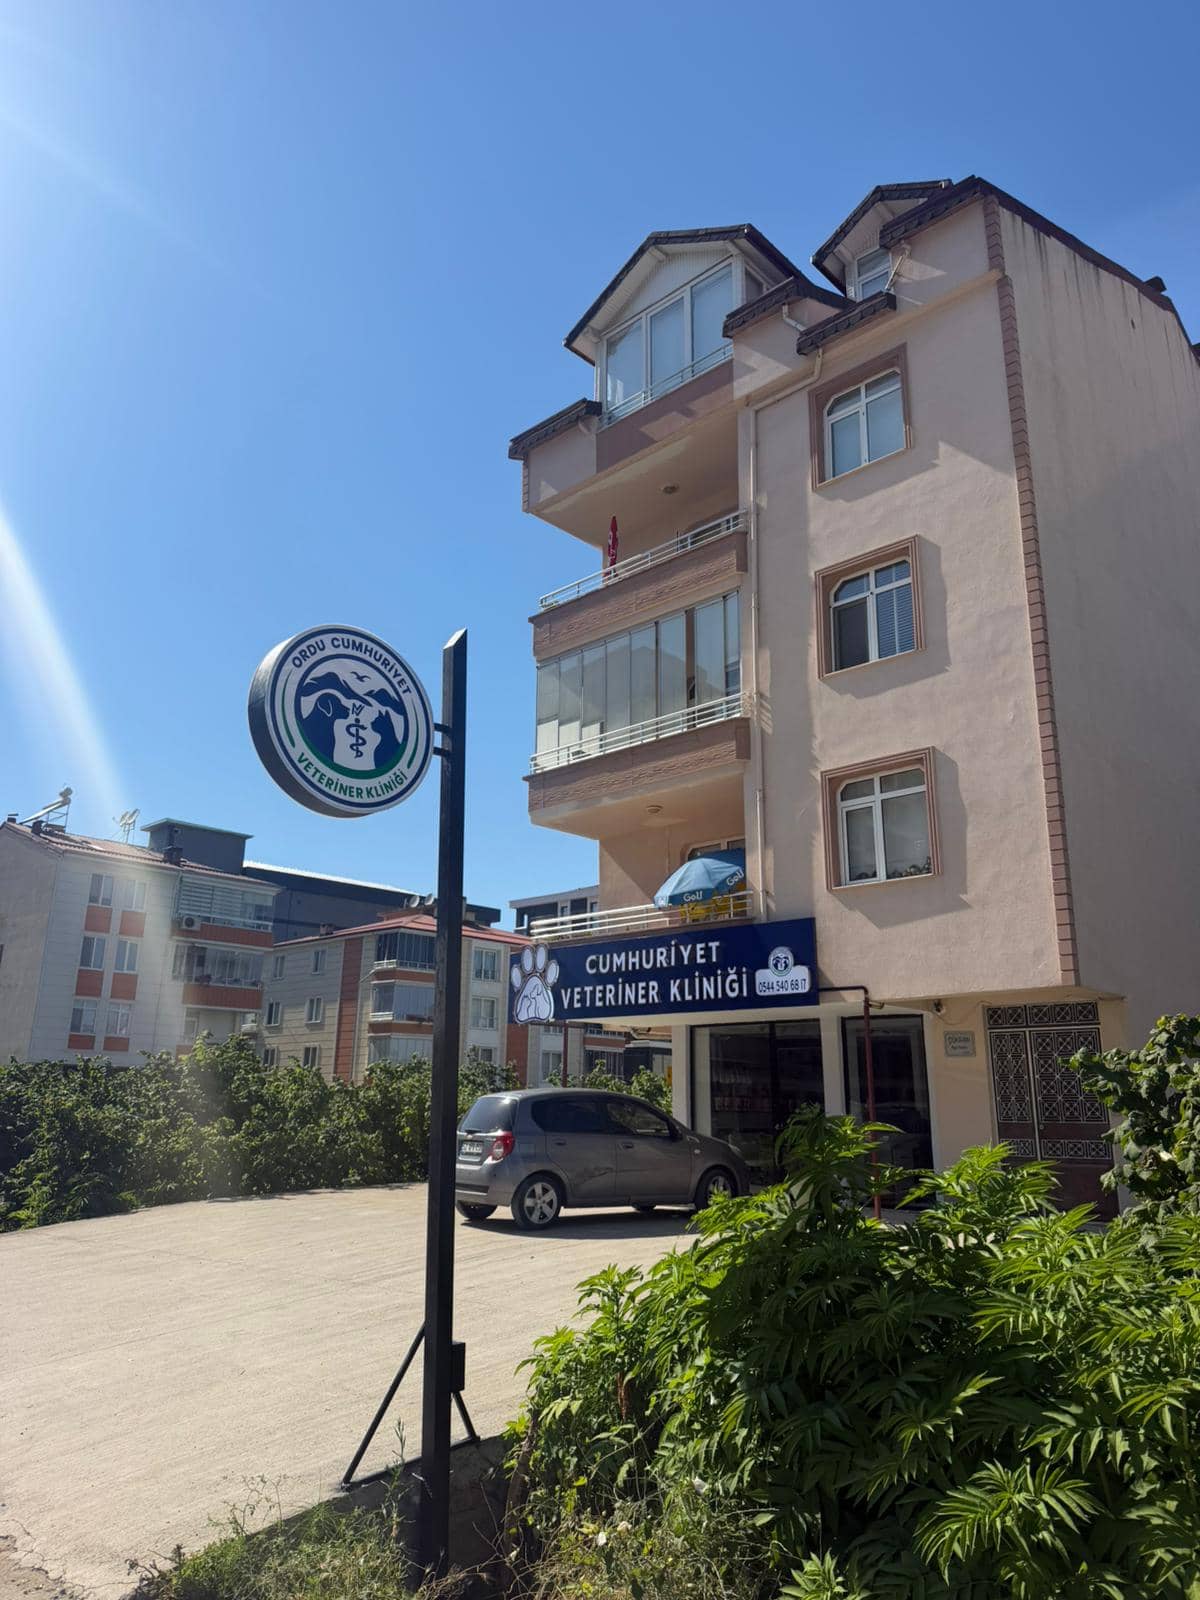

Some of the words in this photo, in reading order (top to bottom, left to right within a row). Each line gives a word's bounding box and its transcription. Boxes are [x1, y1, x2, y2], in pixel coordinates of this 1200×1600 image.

[292, 638, 326, 669] ORDU
[331, 637, 412, 695] CUMHURİYET
[297, 752, 364, 800] VETERİNER
[366, 769, 408, 800] KLİNİĞİ
[585, 940, 721, 975] CUMHURİYET
[560, 978, 660, 1010] VETERİNER
[669, 966, 748, 1003] KLİNİĞİ
